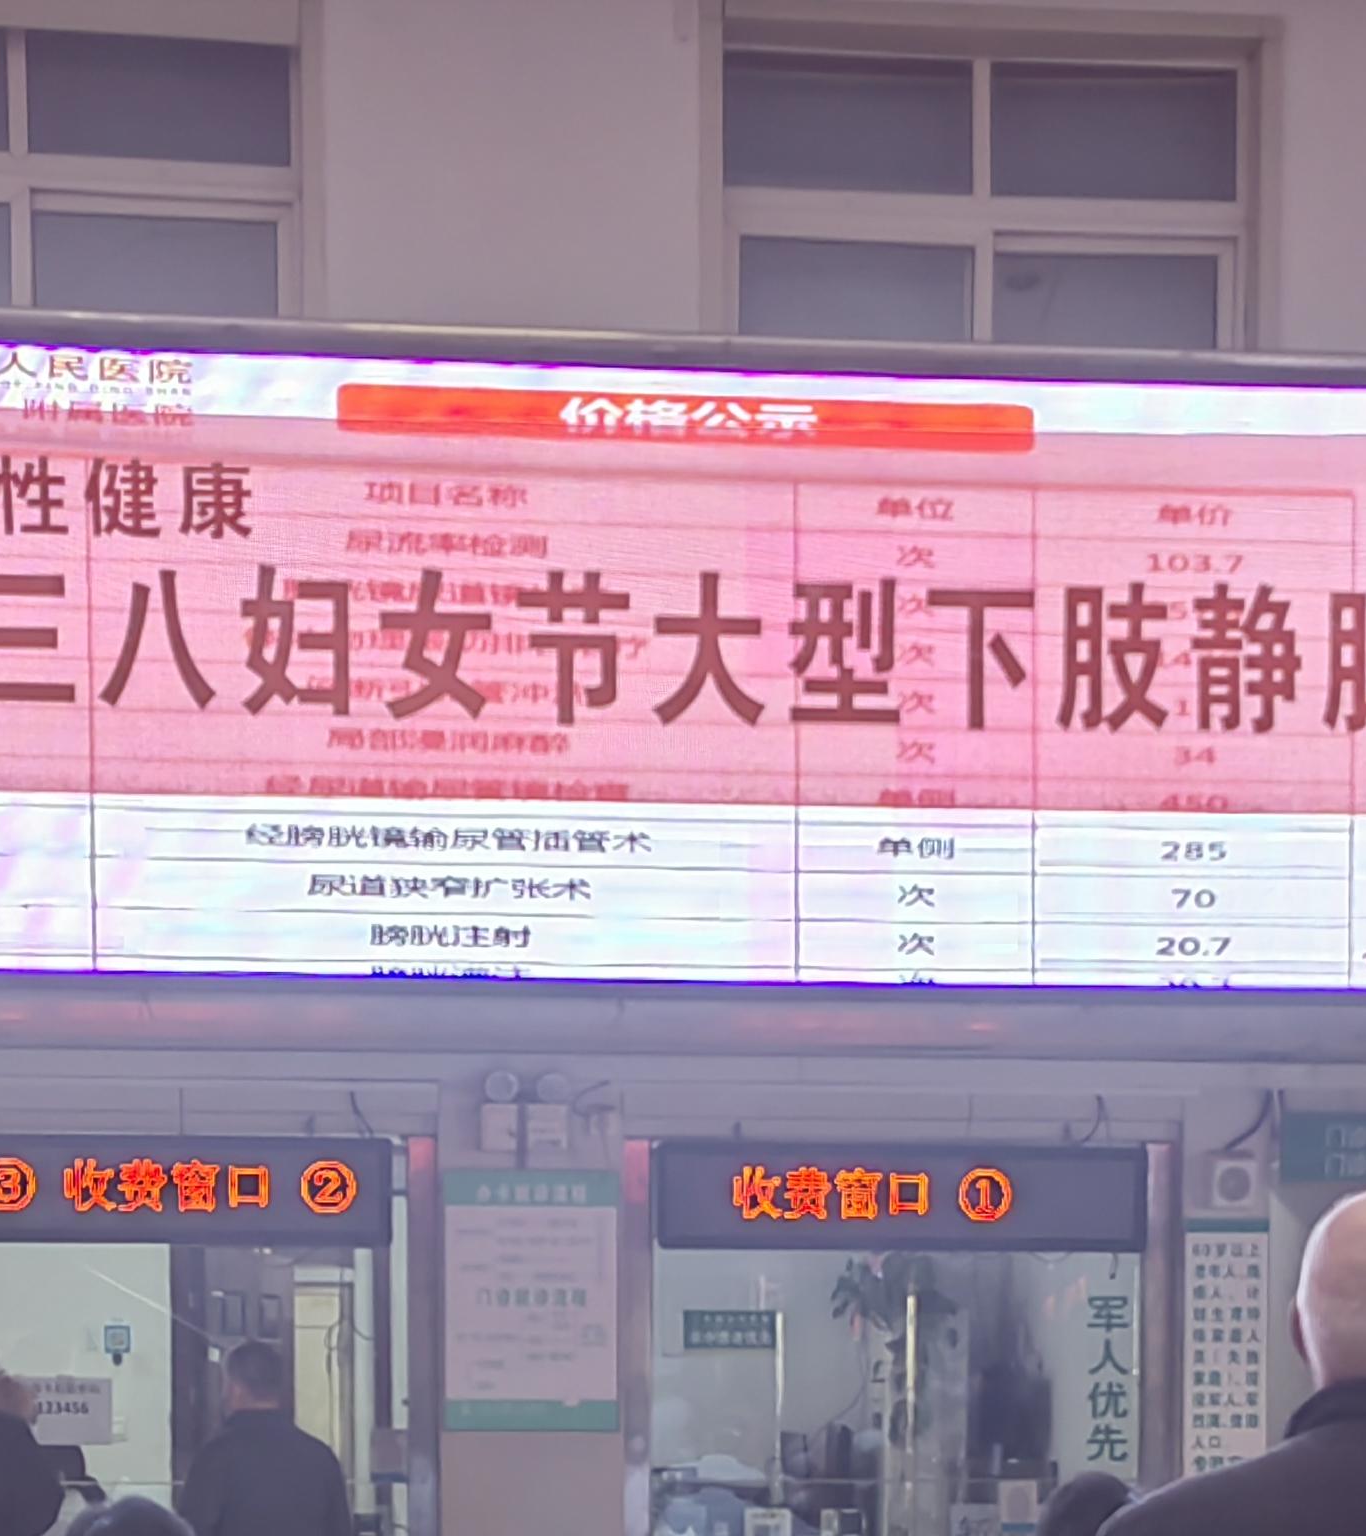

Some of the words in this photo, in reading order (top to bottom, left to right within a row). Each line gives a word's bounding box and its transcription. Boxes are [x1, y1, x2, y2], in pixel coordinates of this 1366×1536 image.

[560, 396, 820, 440] 价格公示
[876, 496, 954, 522] 单位
[1157, 503, 1233, 528] 单价
[896, 545, 935, 569] 次
[1146, 553, 1243, 575] 103.7
[245, 823, 653, 854] 经膀胱镜输尿管插管术
[877, 836, 955, 860] 单侧
[1160, 840, 1229, 862] 285
[307, 873, 593, 901] 尿道狭窄扩张术
[897, 884, 936, 908] 次
[1171, 888, 1218, 910] 70
[370, 923, 532, 949] 膀胱注射
[897, 933, 936, 957] 次
[1155, 935, 1233, 958] 20.7
[62, 1157, 271, 1213] 收费窗口
[731, 1164, 930, 1220] 收费窗口
[1085, 1294, 1130, 1463] 军人优先
